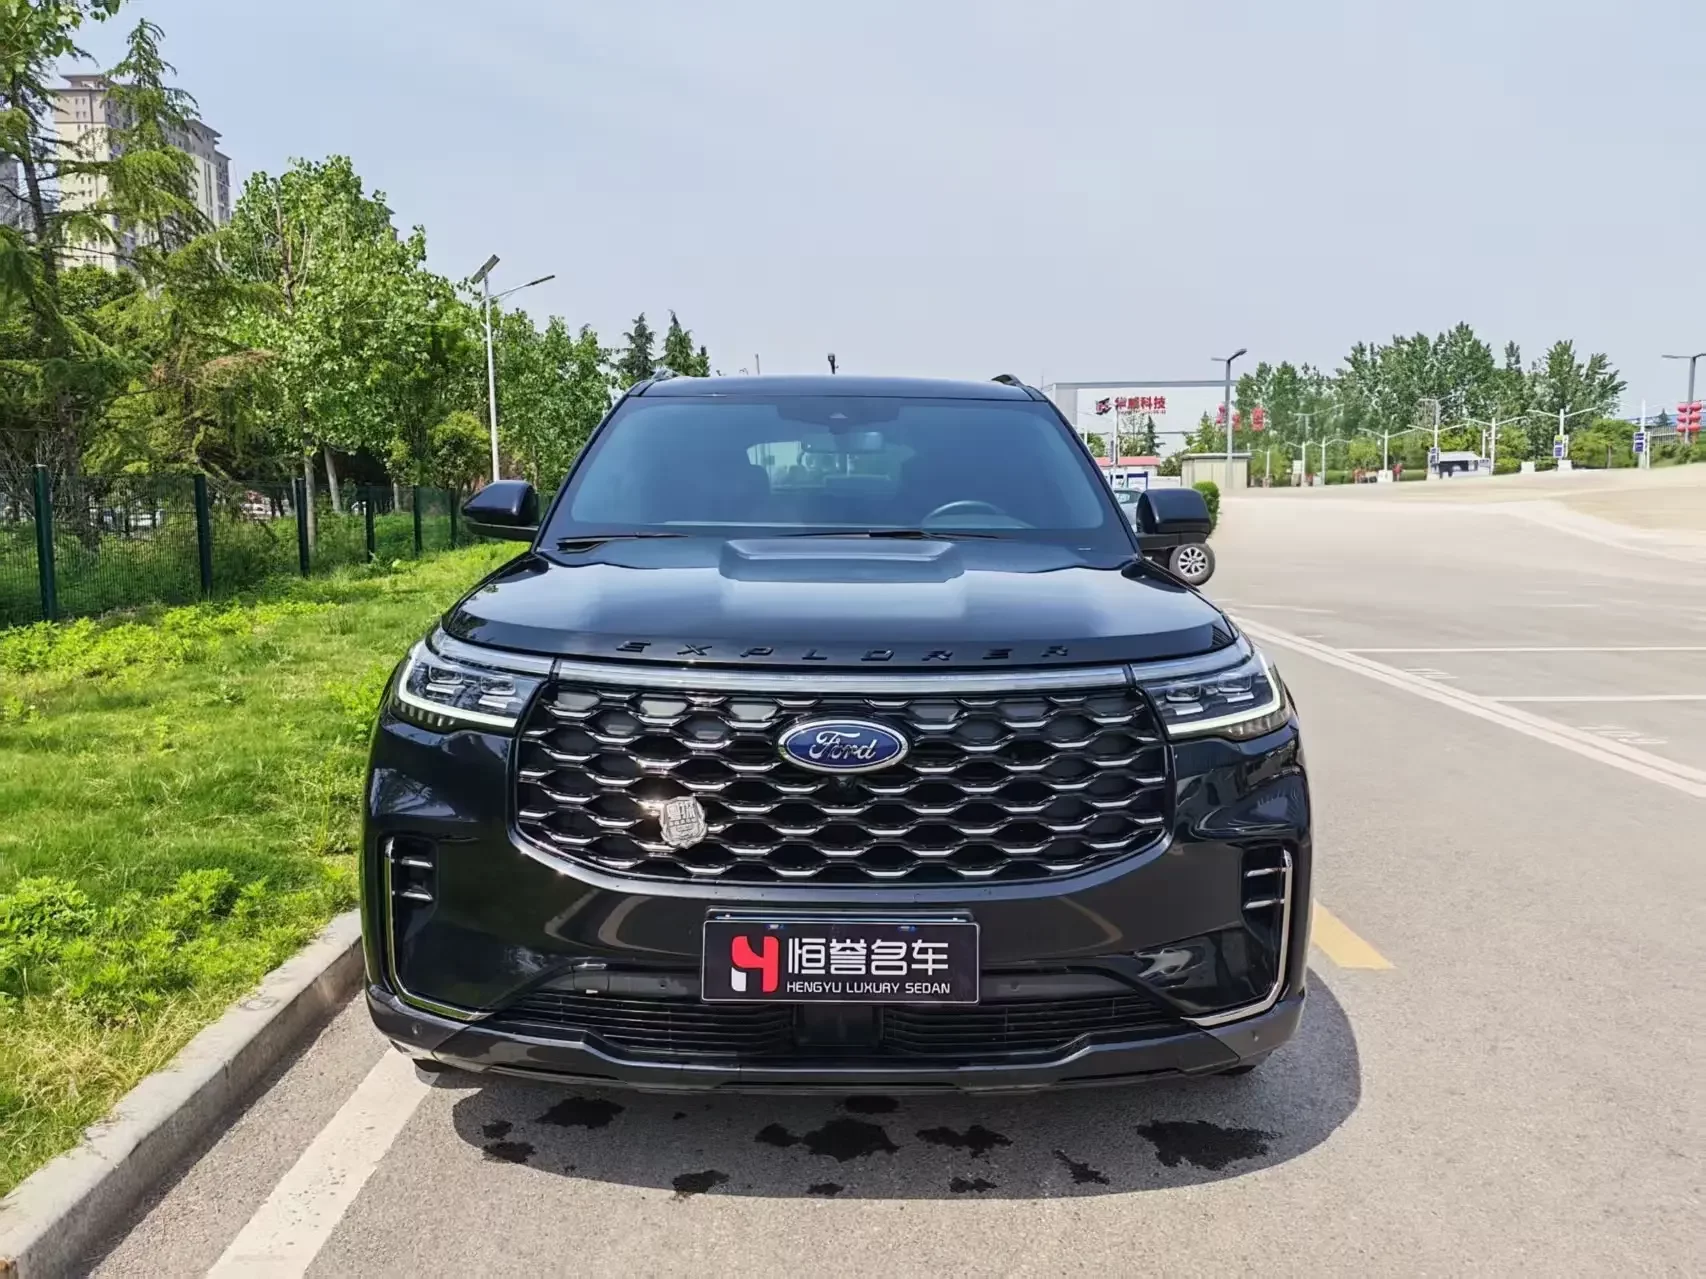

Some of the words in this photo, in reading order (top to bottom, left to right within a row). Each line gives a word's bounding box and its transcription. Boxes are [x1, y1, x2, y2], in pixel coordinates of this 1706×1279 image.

[615, 639, 1069, 662] EXPLORER
[808, 730, 878, 760] Ford
[787, 937, 949, 976] 恒誉名车
[786, 981, 842, 993] HENGYU
[846, 981, 900, 994] LUXURY
[905, 982, 951, 994] SEDAN
